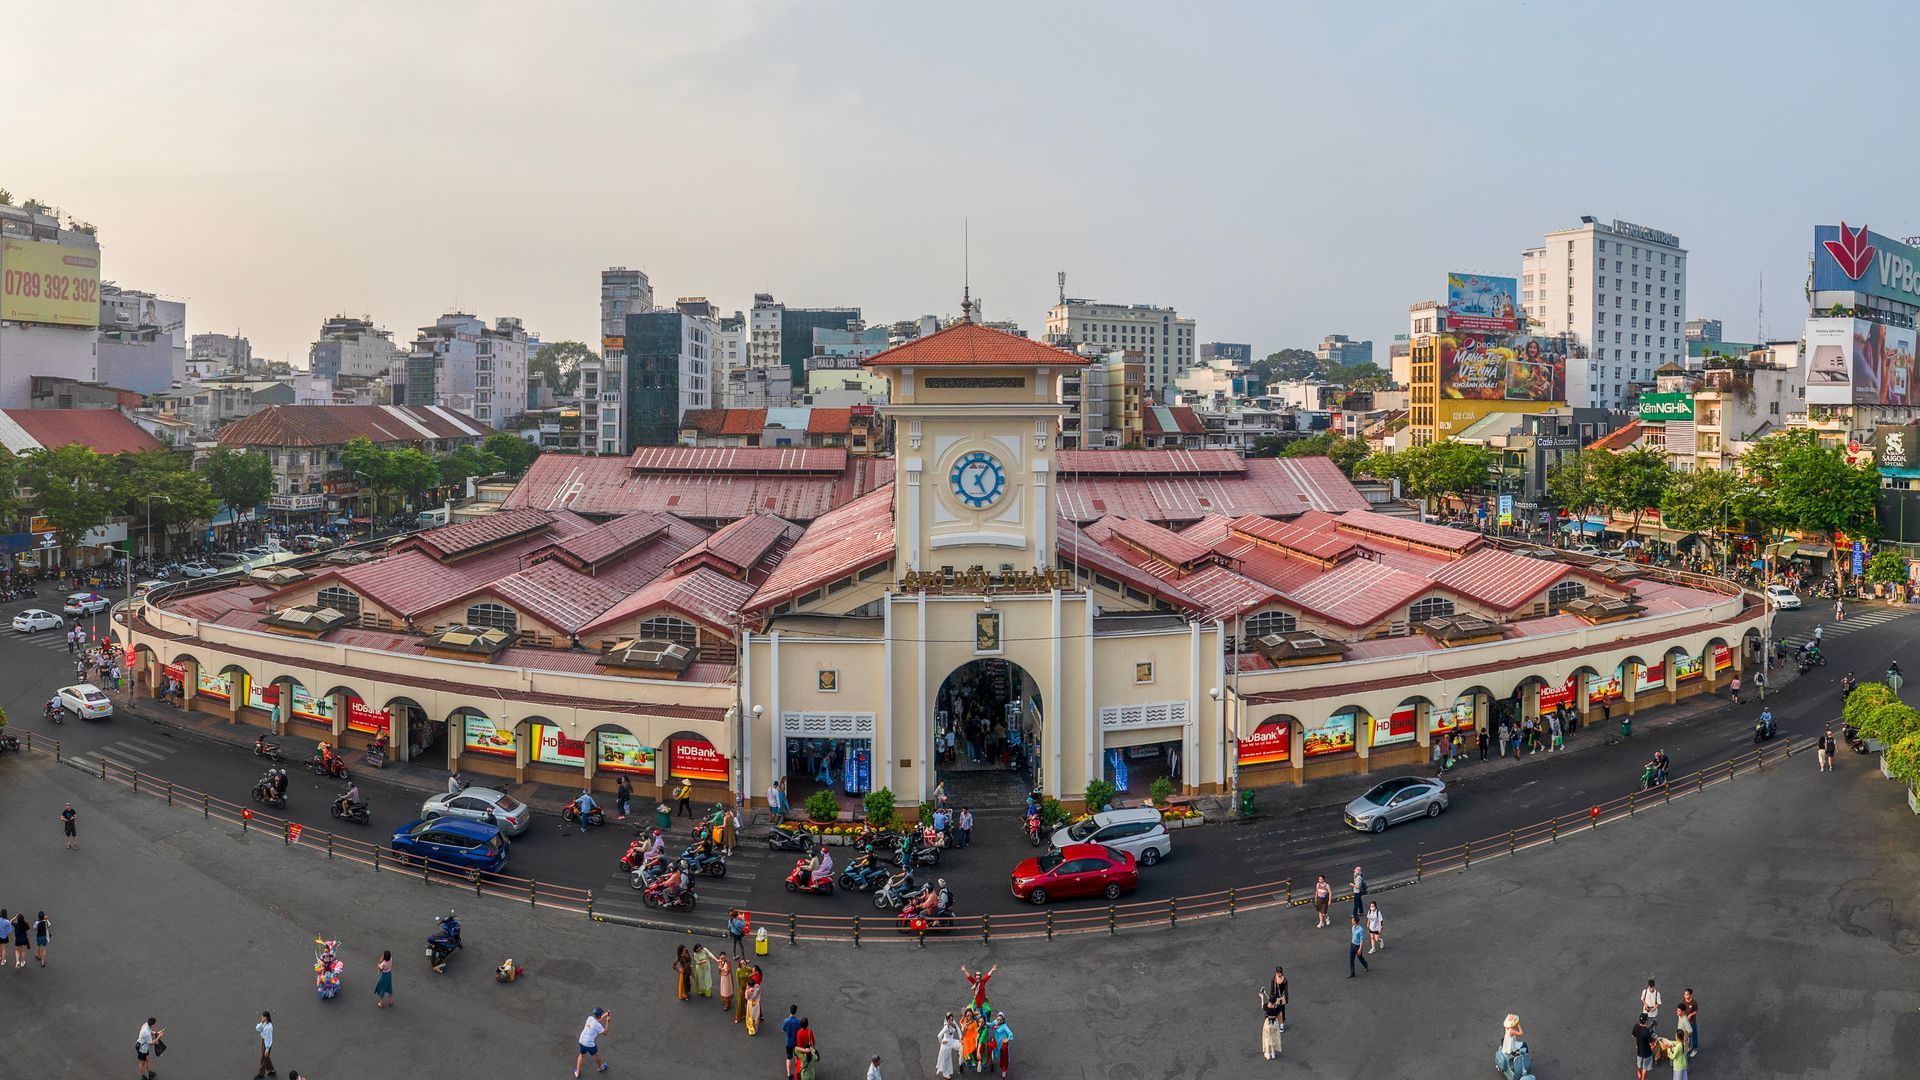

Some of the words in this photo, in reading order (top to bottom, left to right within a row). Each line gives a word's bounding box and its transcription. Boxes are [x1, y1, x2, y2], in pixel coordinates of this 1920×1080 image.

[5, 269, 40, 298] 0789
[44, 273, 69, 300] 392
[73, 277, 96, 303] 392
[1476, 341, 1498, 350] pepsi
[817, 358, 834, 368] HALO
[837, 359, 858, 368] HOTEL
[1452, 350, 1485, 364] MANG
[1537, 436, 1553, 446] Café
[1553, 438, 1578, 446] Amazon
[1376, 718, 1414, 731] HDBank
[543, 737, 585, 751] HDBank
[677, 745, 716, 758] HDBank
